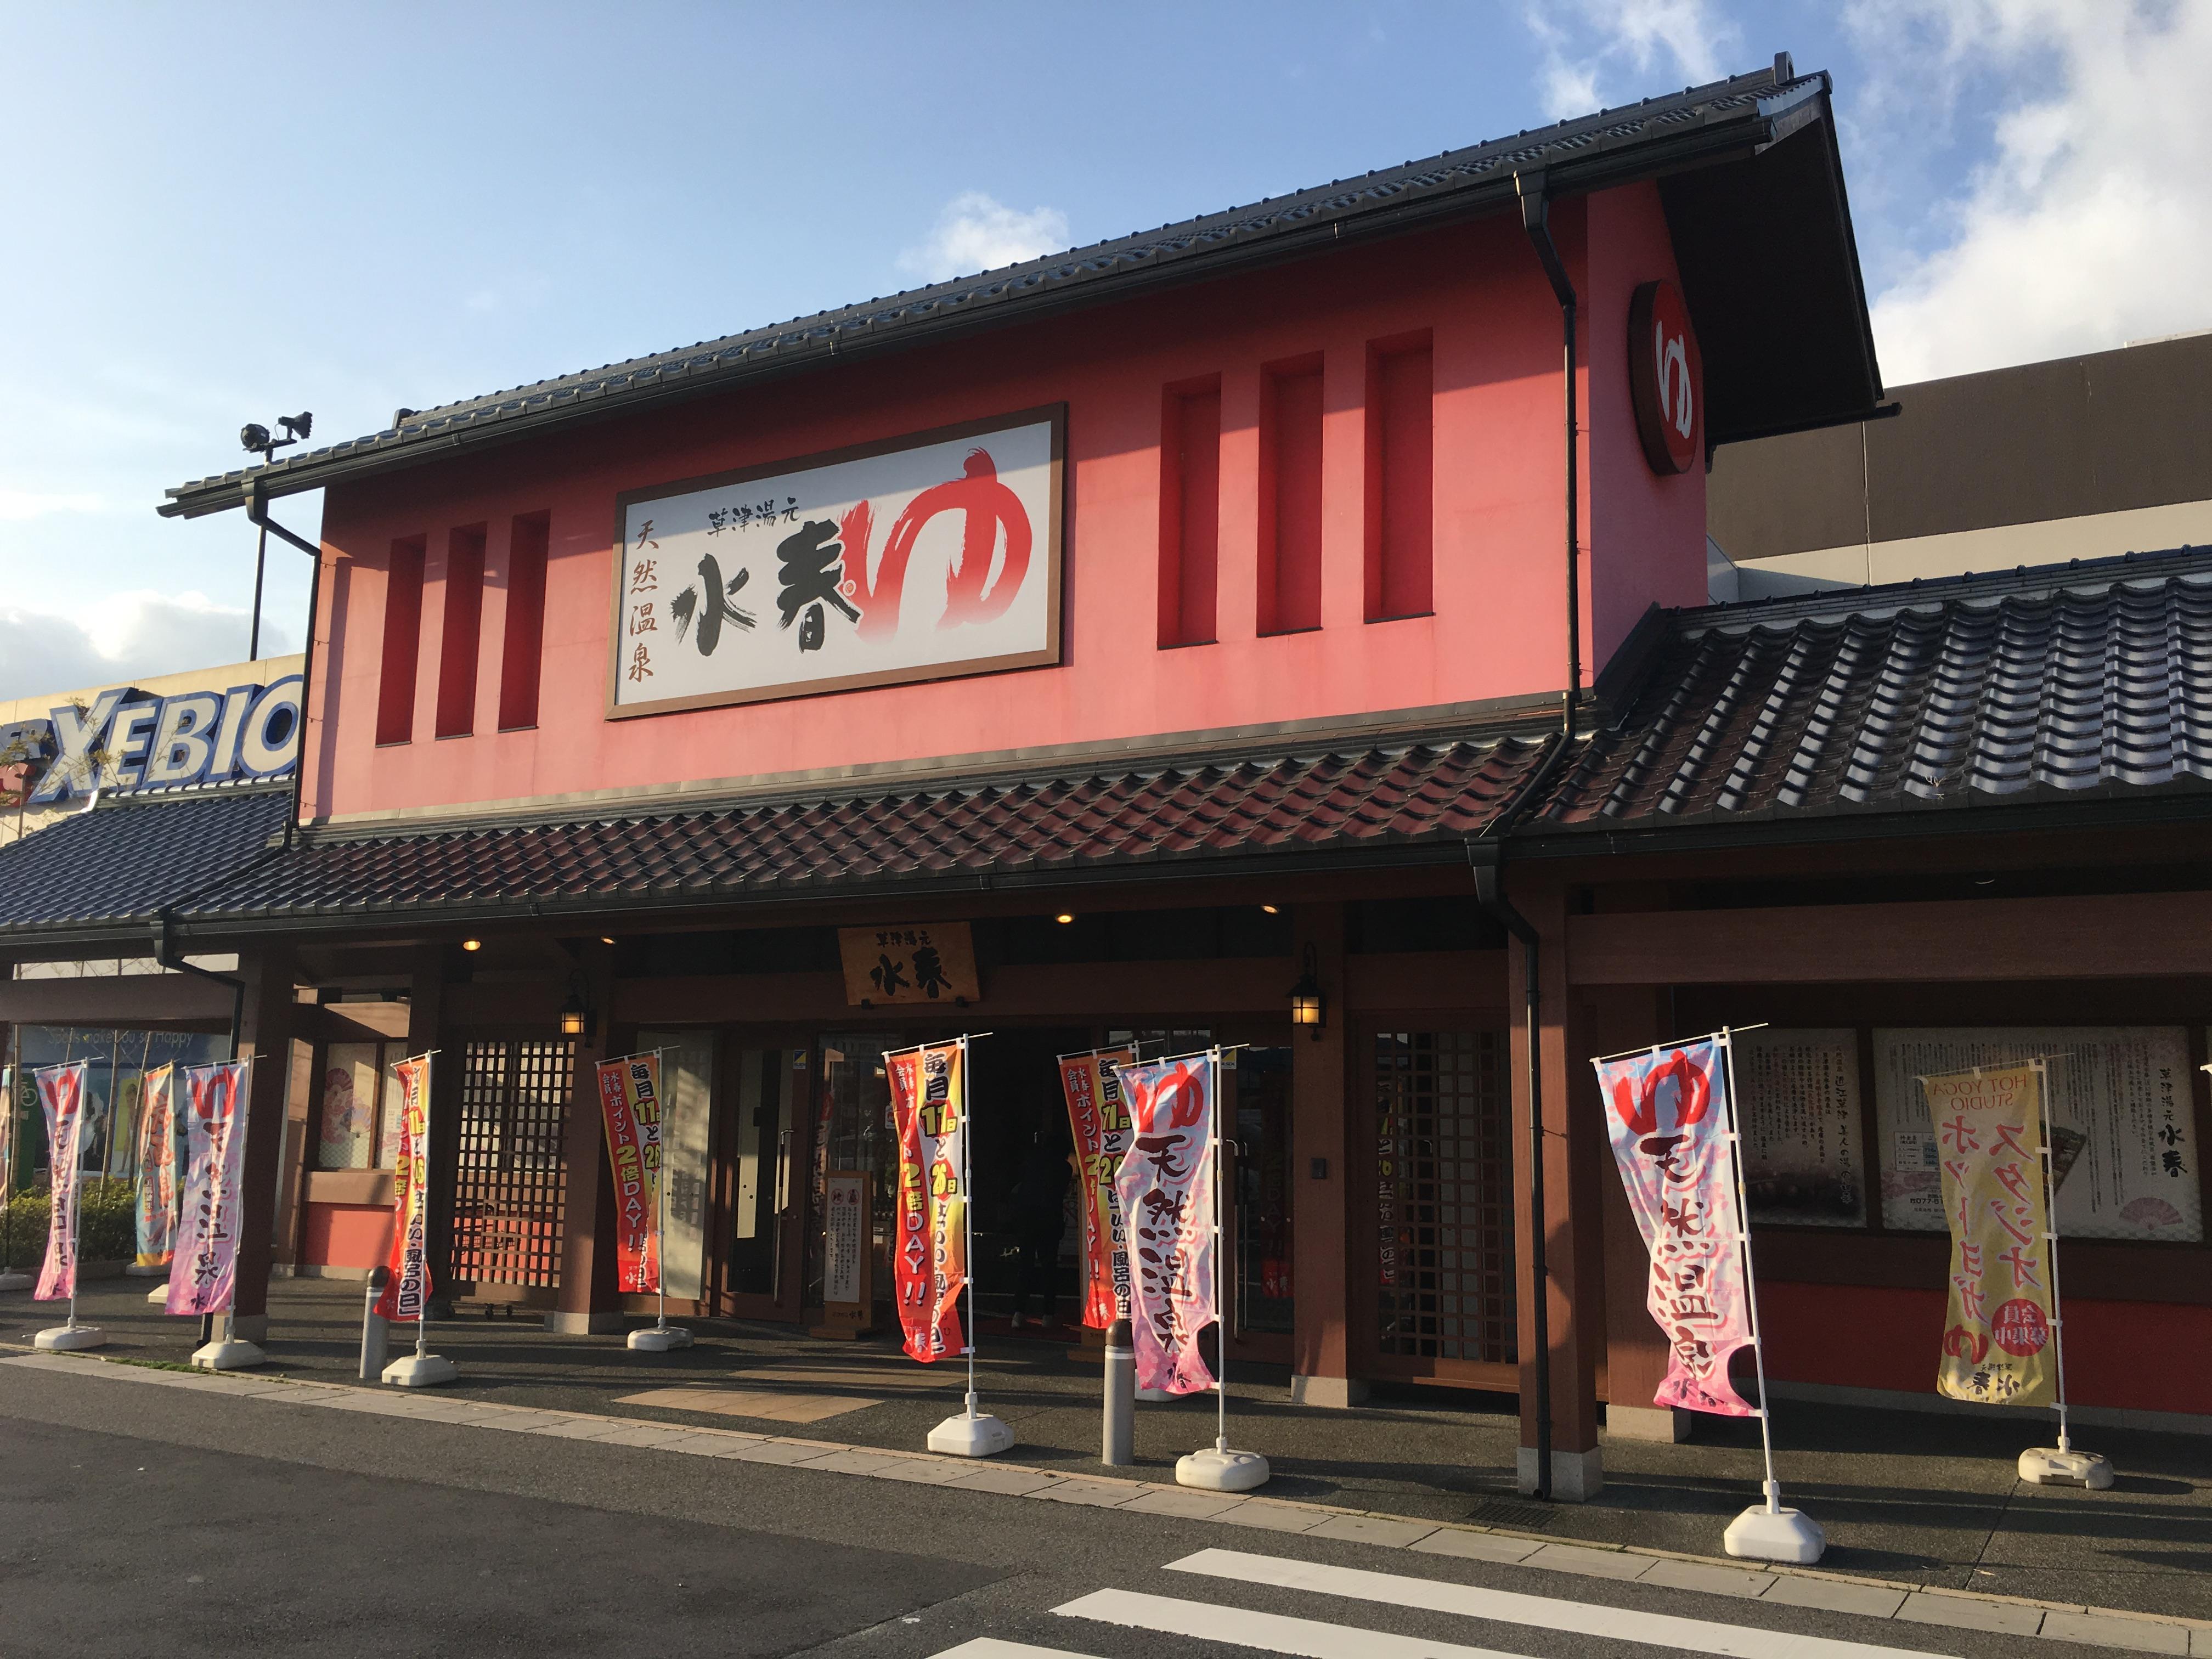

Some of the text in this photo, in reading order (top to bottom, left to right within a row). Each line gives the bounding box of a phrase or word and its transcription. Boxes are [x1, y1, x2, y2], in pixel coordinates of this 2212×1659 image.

[1655, 320, 1693, 439] ゆ
[706, 496, 800, 538] 草津湯元
[837, 445, 1034, 644] ゆ
[628, 519, 659, 683] 天然温泉
[669, 518, 865, 657] 水春
[27, 674, 304, 804] XEBIO
[869, 946, 953, 1000] 水春
[155, 1032, 194, 1048] Happy
[45, 1068, 80, 1115] ゆ
[191, 1066, 237, 1119] ゆ
[1067, 1069, 1080, 1093] 会員
[1135, 1061, 1204, 1133] ゆ
[1612, 1048, 1711, 1136] ゆ
[2157, 1124, 2188, 1178] 水春
